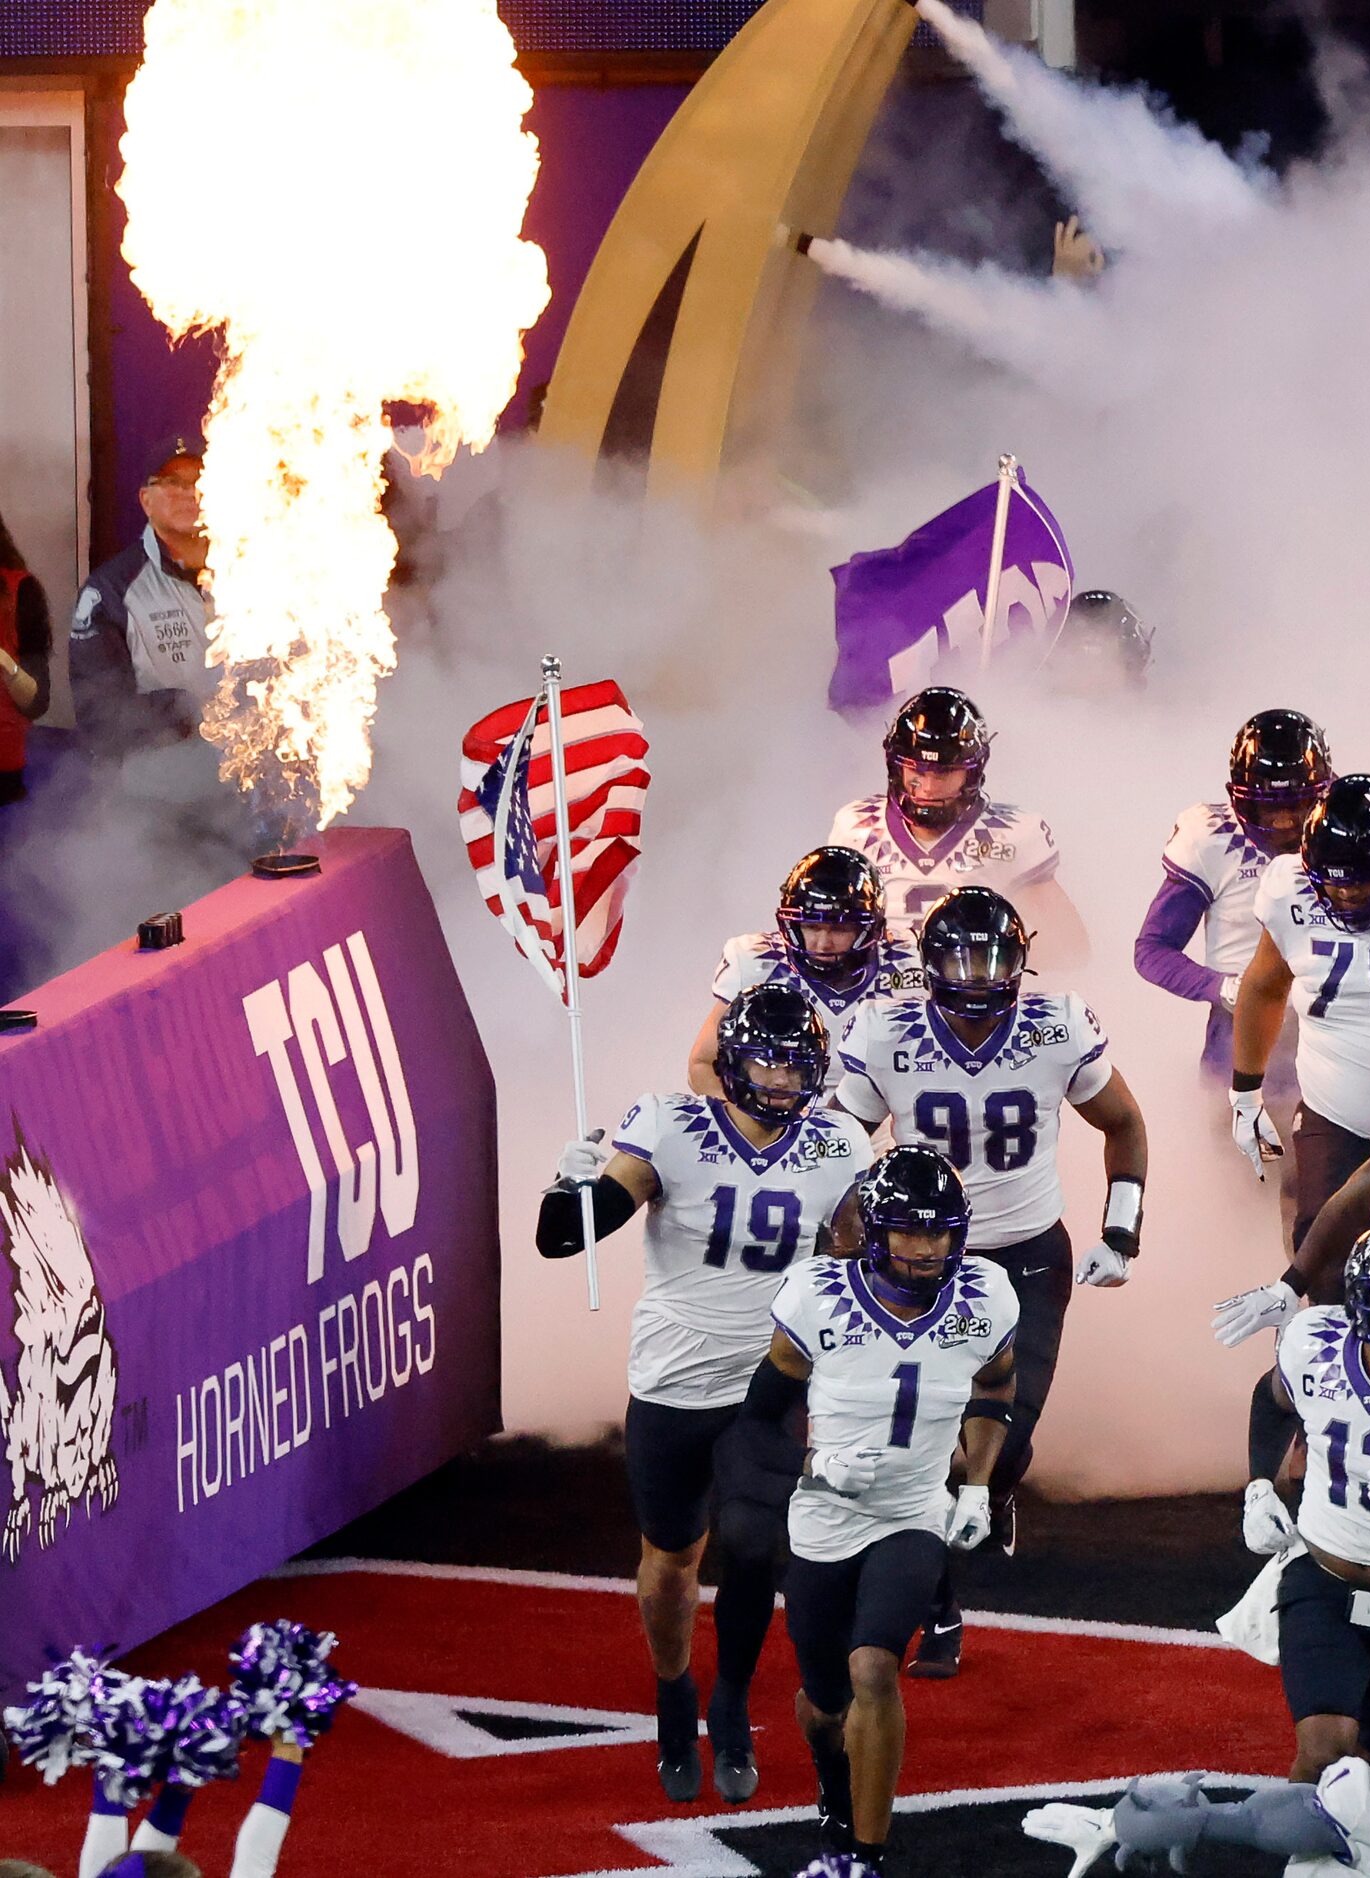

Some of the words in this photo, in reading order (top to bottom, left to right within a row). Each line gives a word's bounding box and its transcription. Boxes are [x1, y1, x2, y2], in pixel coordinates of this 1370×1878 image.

[154, 622, 188, 640] 5666
[921, 751, 938, 761] TCU
[965, 838, 1017, 862] 2023
[1327, 868, 1344, 878] TCU
[1290, 904, 1304, 925] C
[970, 932, 988, 942] TCU
[880, 971, 924, 990] 2023
[1018, 1024, 1069, 1048] 2023
[893, 1051, 909, 1073] C
[242, 931, 419, 1284] TCU
[915, 1090, 1039, 1172] 98
[803, 1139, 851, 1160] 2023
[917, 1209, 936, 1219] TCU
[702, 1184, 803, 1273] 19
[944, 1314, 992, 1337] 2023
[819, 1328, 836, 1350] C
[176, 1324, 312, 1513] HORNED
[319, 1253, 436, 1429] FROGS
[1302, 1374, 1315, 1397] C
[888, 1361, 922, 1449] 1
